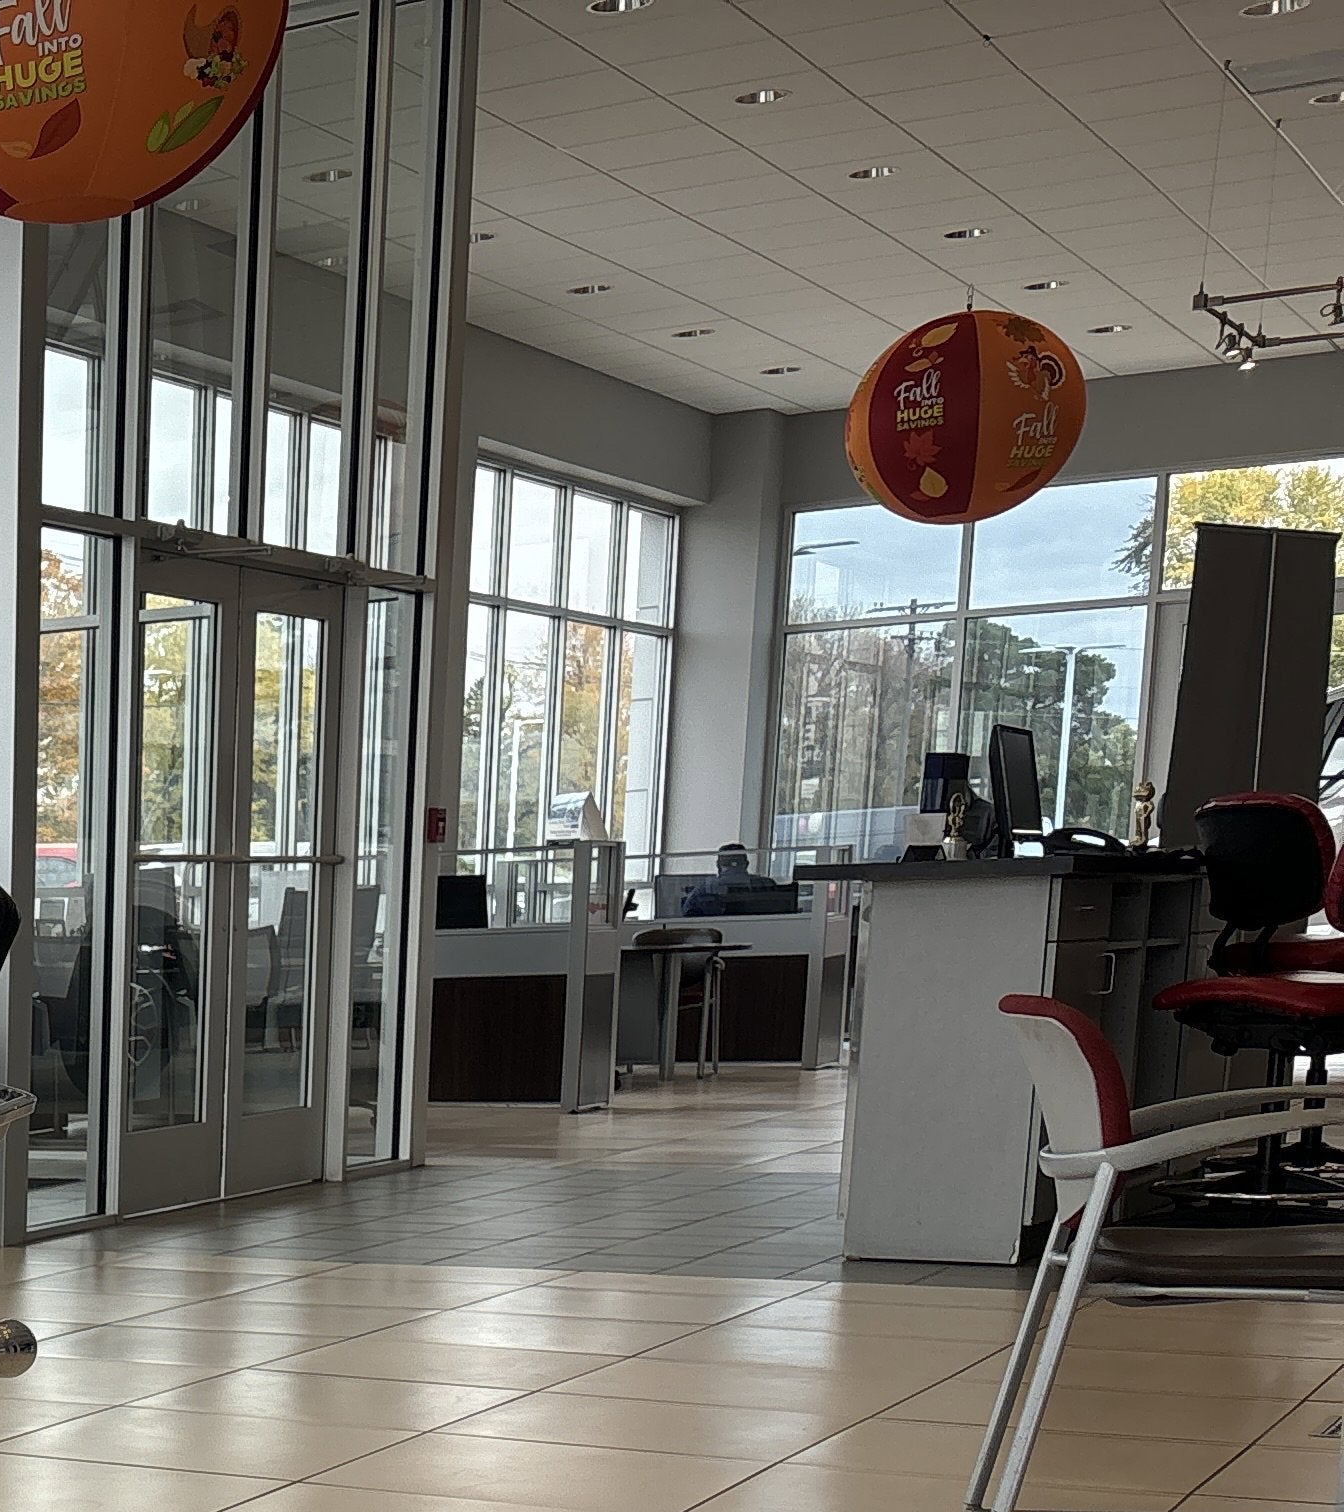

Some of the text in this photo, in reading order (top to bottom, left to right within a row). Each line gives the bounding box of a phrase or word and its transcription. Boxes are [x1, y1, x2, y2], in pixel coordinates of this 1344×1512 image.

[38, 33, 83, 56] INTO
[894, 369, 941, 410] Fall
[921, 397, 945, 406] INTO
[897, 405, 944, 422] HUGE
[897, 417, 944, 431] SAVINGS
[1013, 401, 1059, 446] Fall
[1010, 445, 1055, 458] HUGE
